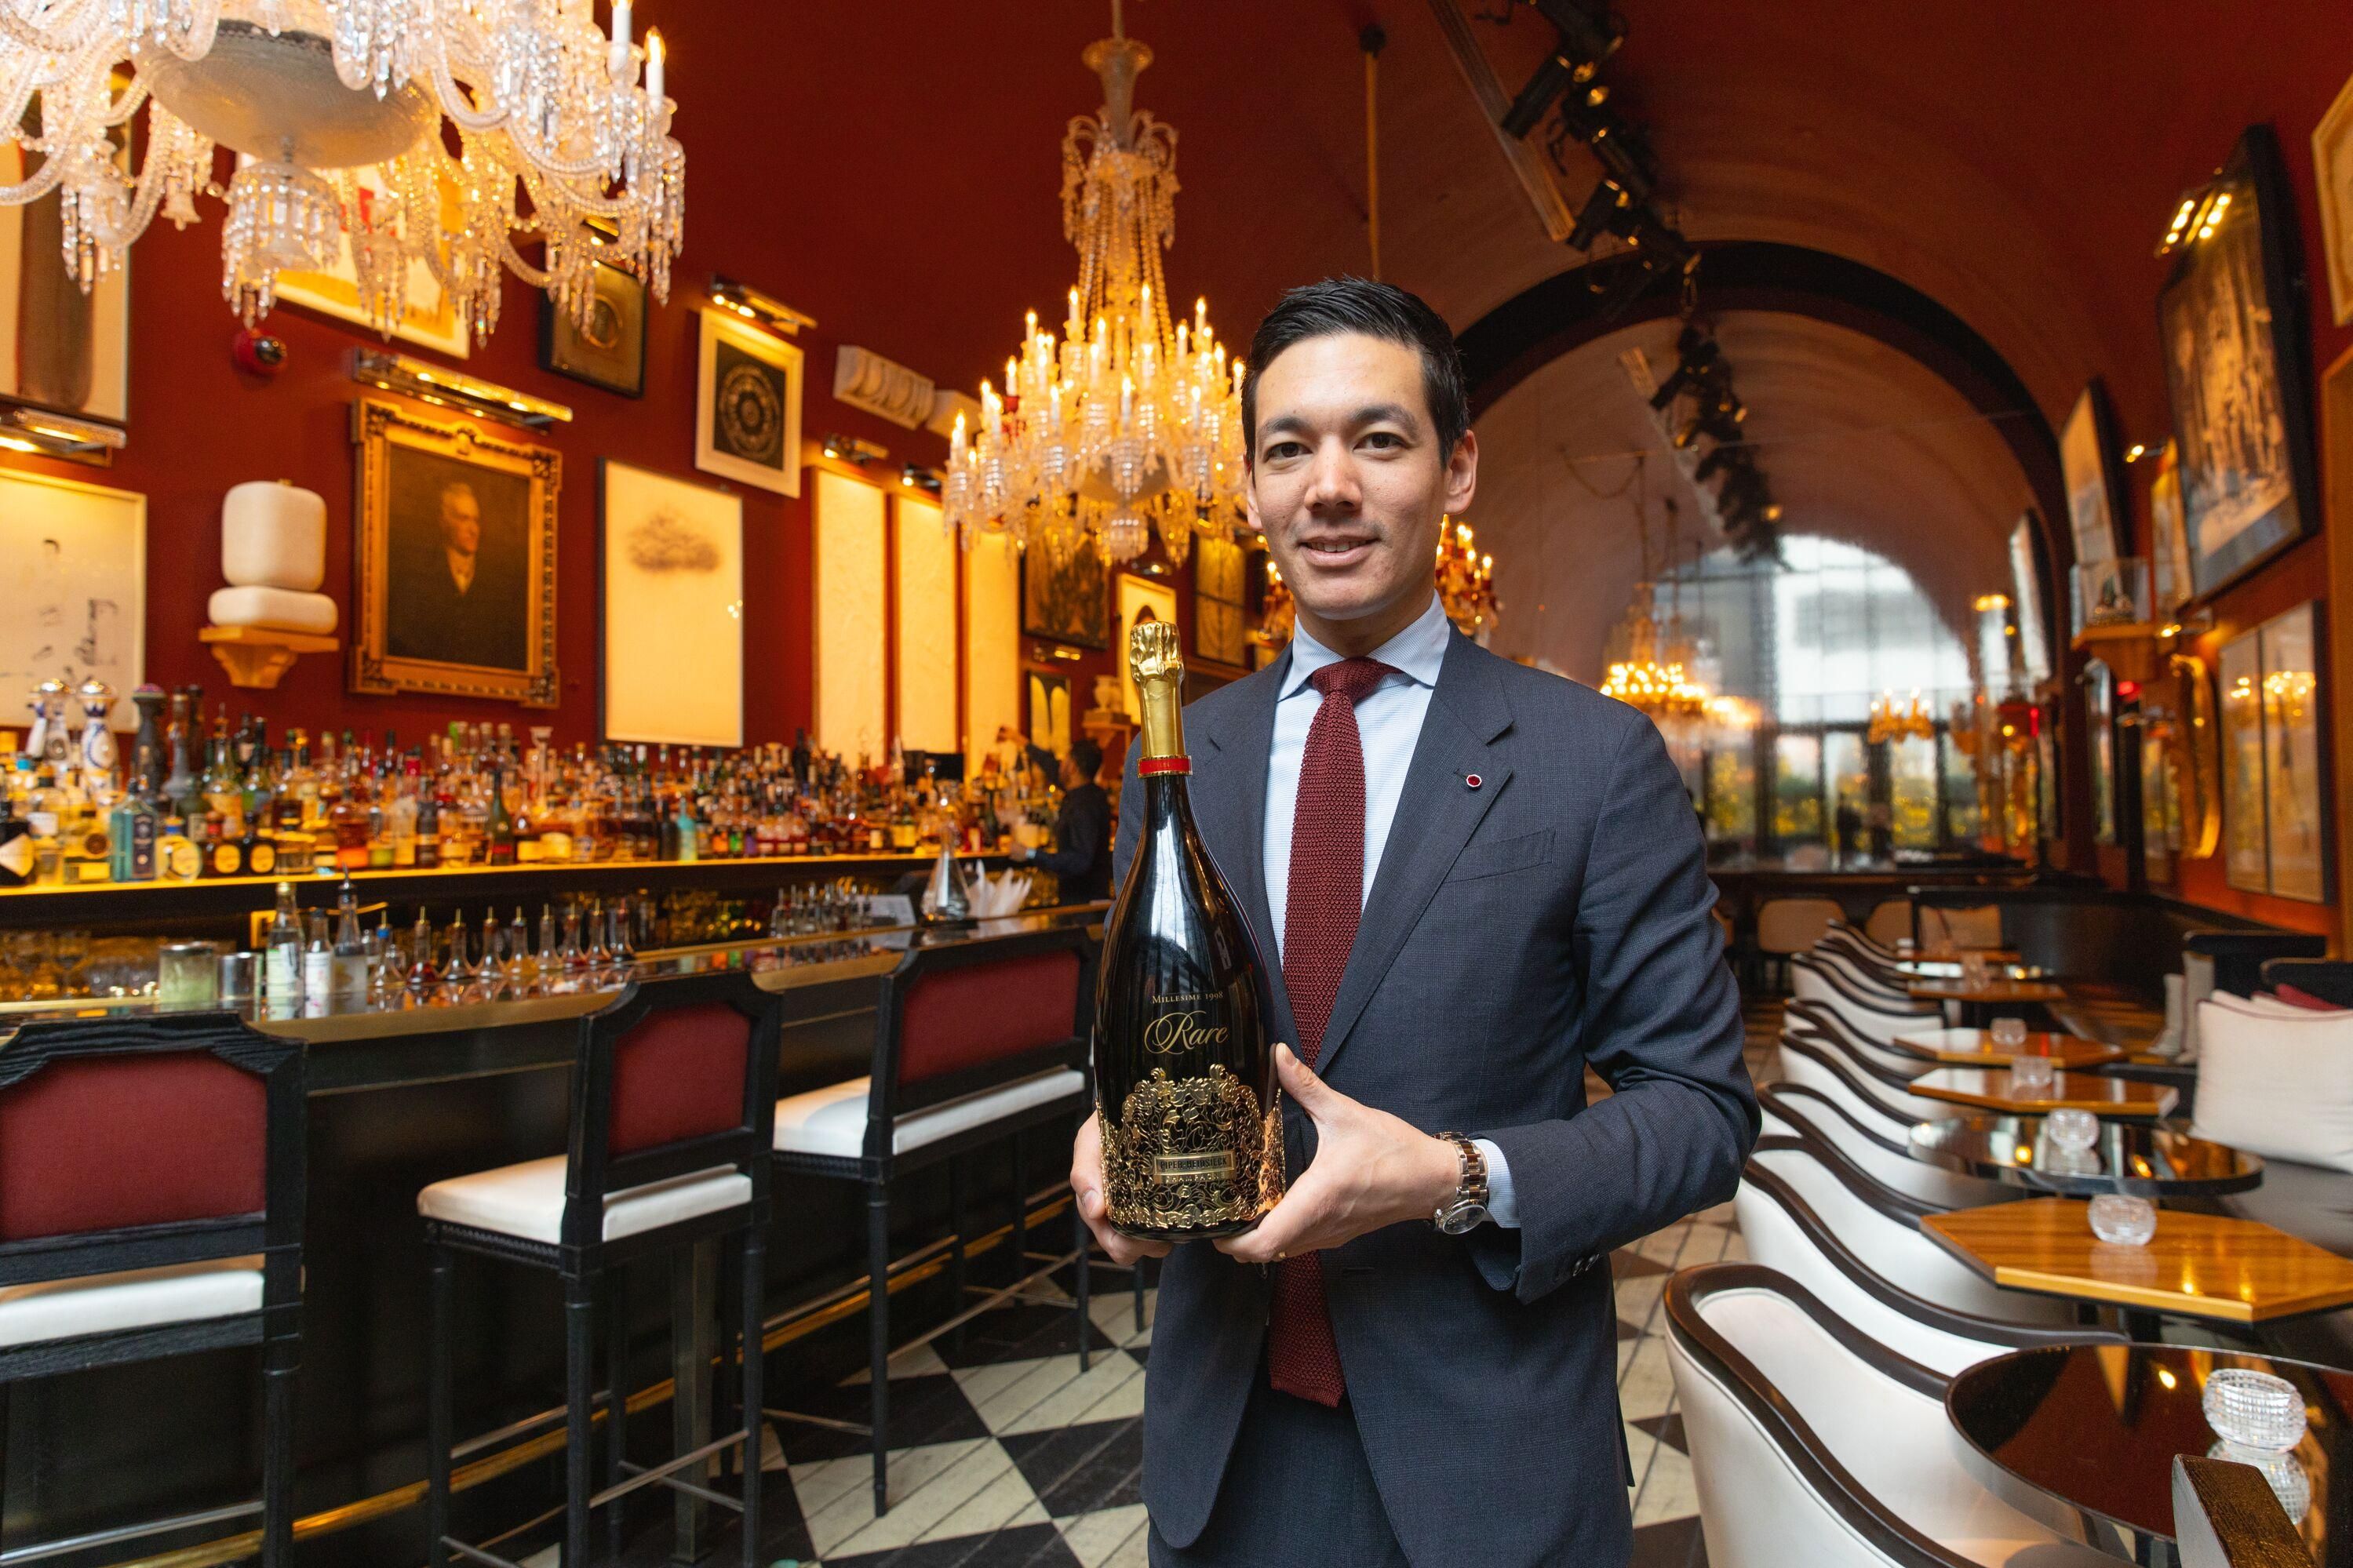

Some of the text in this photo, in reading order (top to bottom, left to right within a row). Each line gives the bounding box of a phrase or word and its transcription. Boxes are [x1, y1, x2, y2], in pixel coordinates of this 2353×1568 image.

[1205, 991, 1223, 1002] 1998
[1144, 1010, 1229, 1055] Rare
[1160, 1157, 1227, 1170] PIPER-HEIDSIECK
